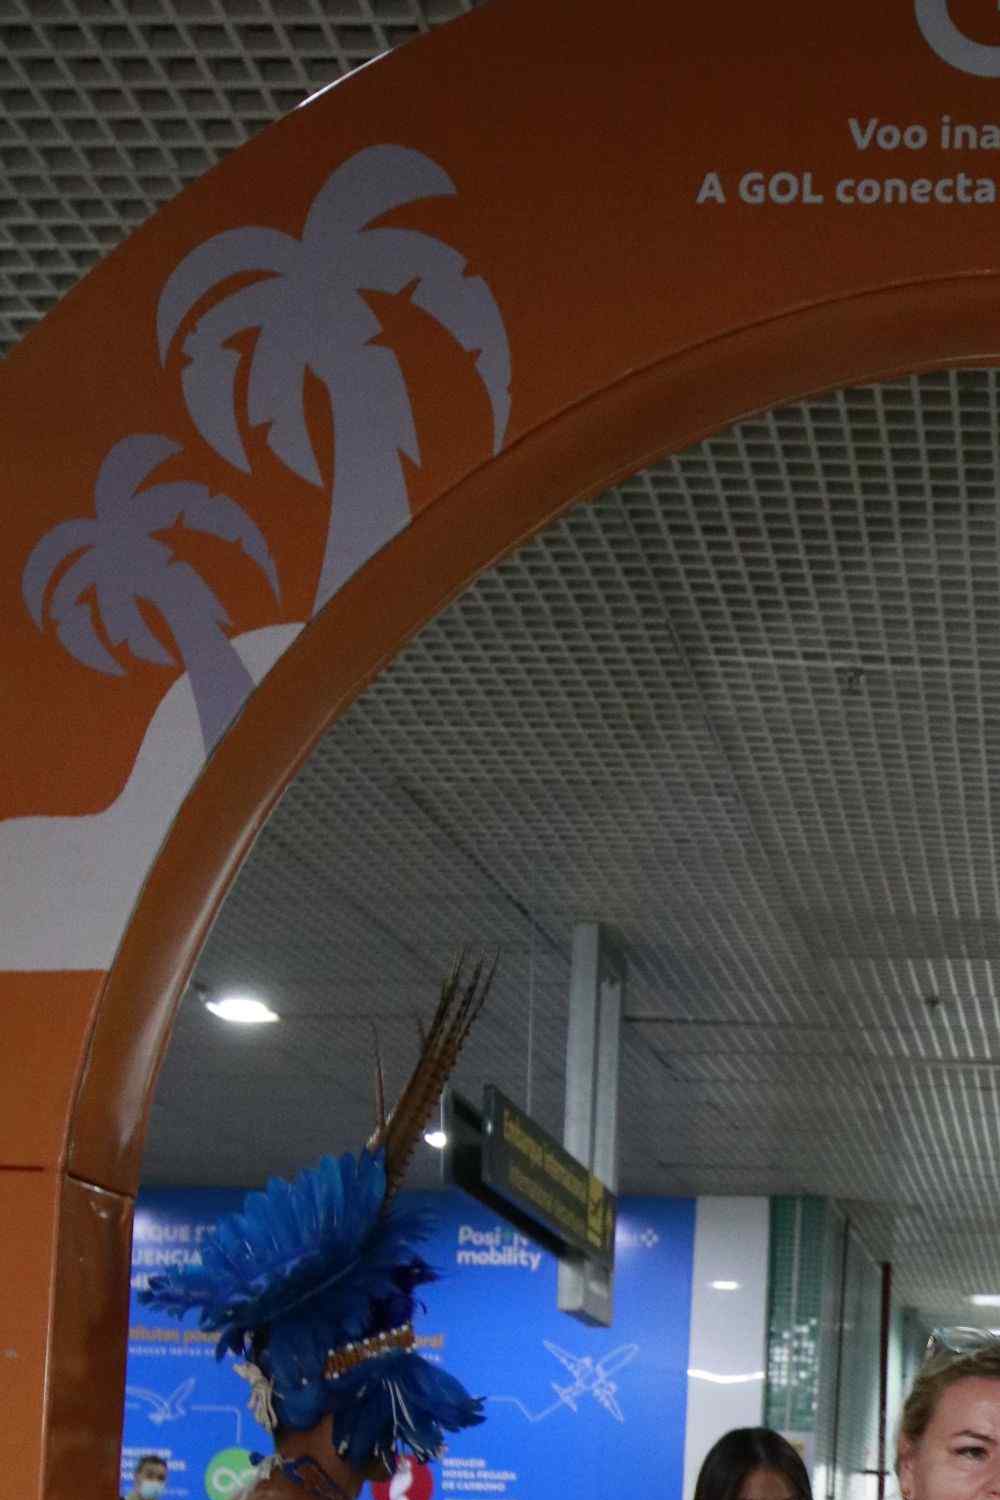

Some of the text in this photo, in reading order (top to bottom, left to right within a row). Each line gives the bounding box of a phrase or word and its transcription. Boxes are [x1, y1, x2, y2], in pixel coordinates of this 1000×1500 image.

[848, 117, 928, 151] Voo
[696, 173, 726, 204] A
[738, 172, 824, 205] GOL
[835, 172, 997, 204] conecta
[456, 1248, 541, 1271] mobility
